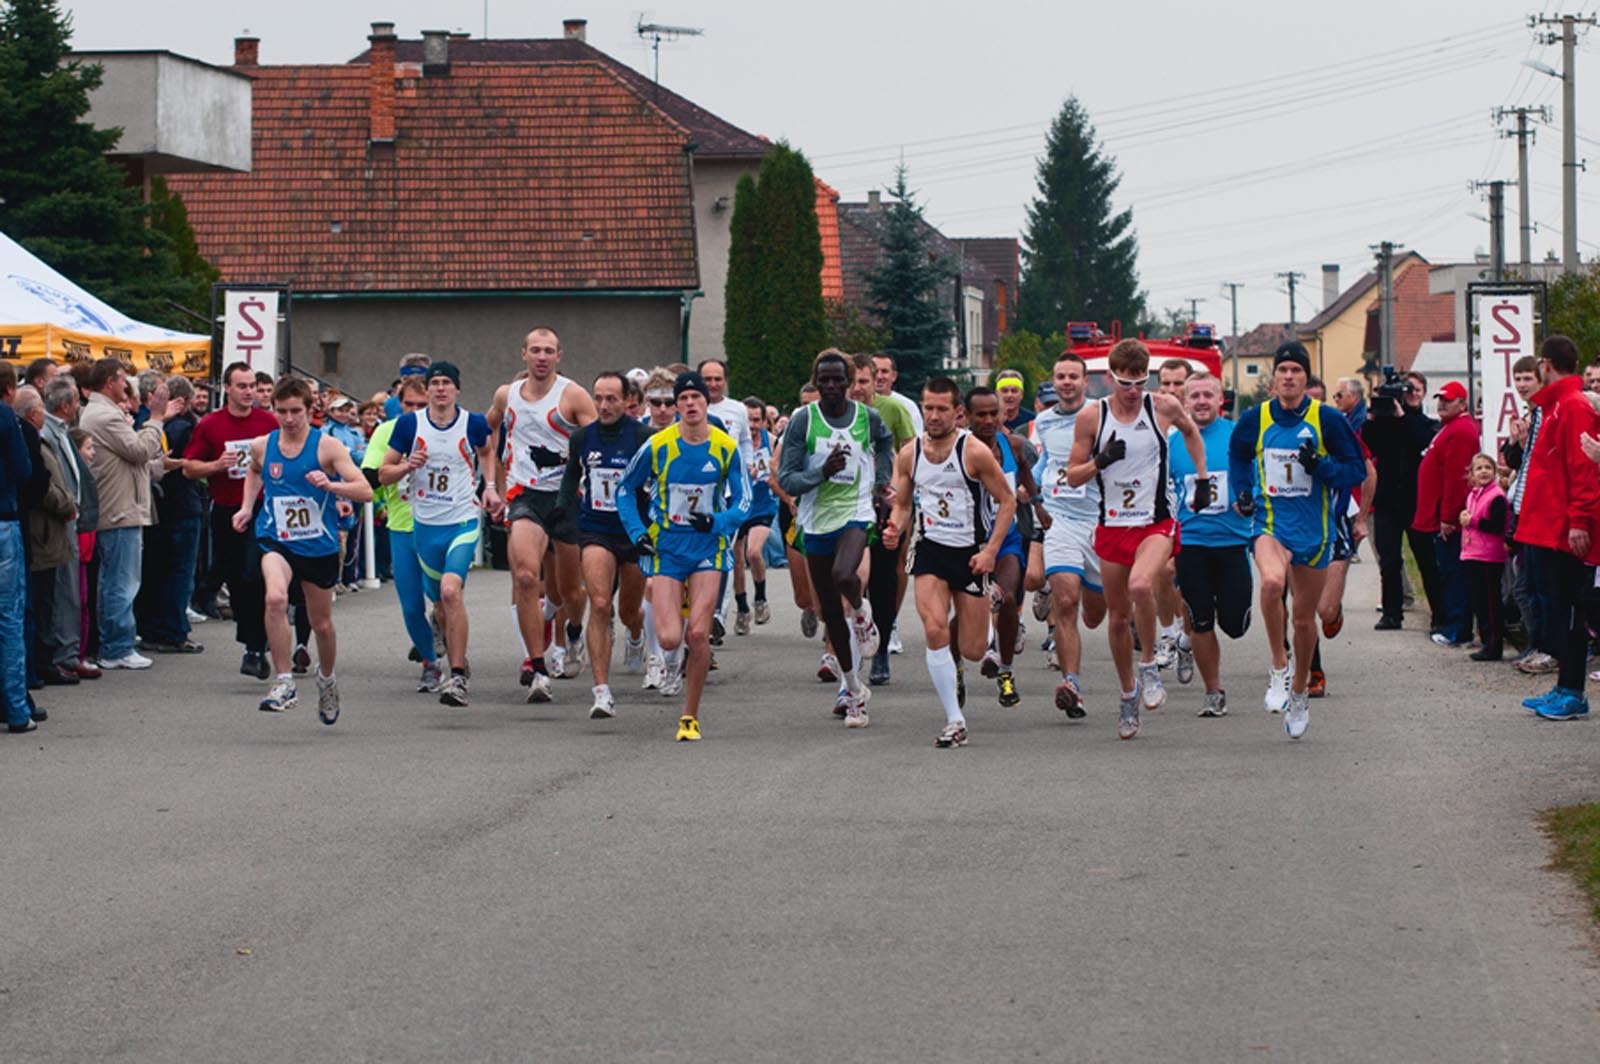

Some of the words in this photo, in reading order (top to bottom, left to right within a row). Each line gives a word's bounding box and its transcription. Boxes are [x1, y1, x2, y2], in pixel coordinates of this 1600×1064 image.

[428, 471, 449, 493] 18
[1284, 463, 1293, 485] 1
[687, 495, 699, 514] 7
[938, 498, 950, 518] 3
[1122, 489, 1135, 509] 2
[285, 508, 311, 529] 20
